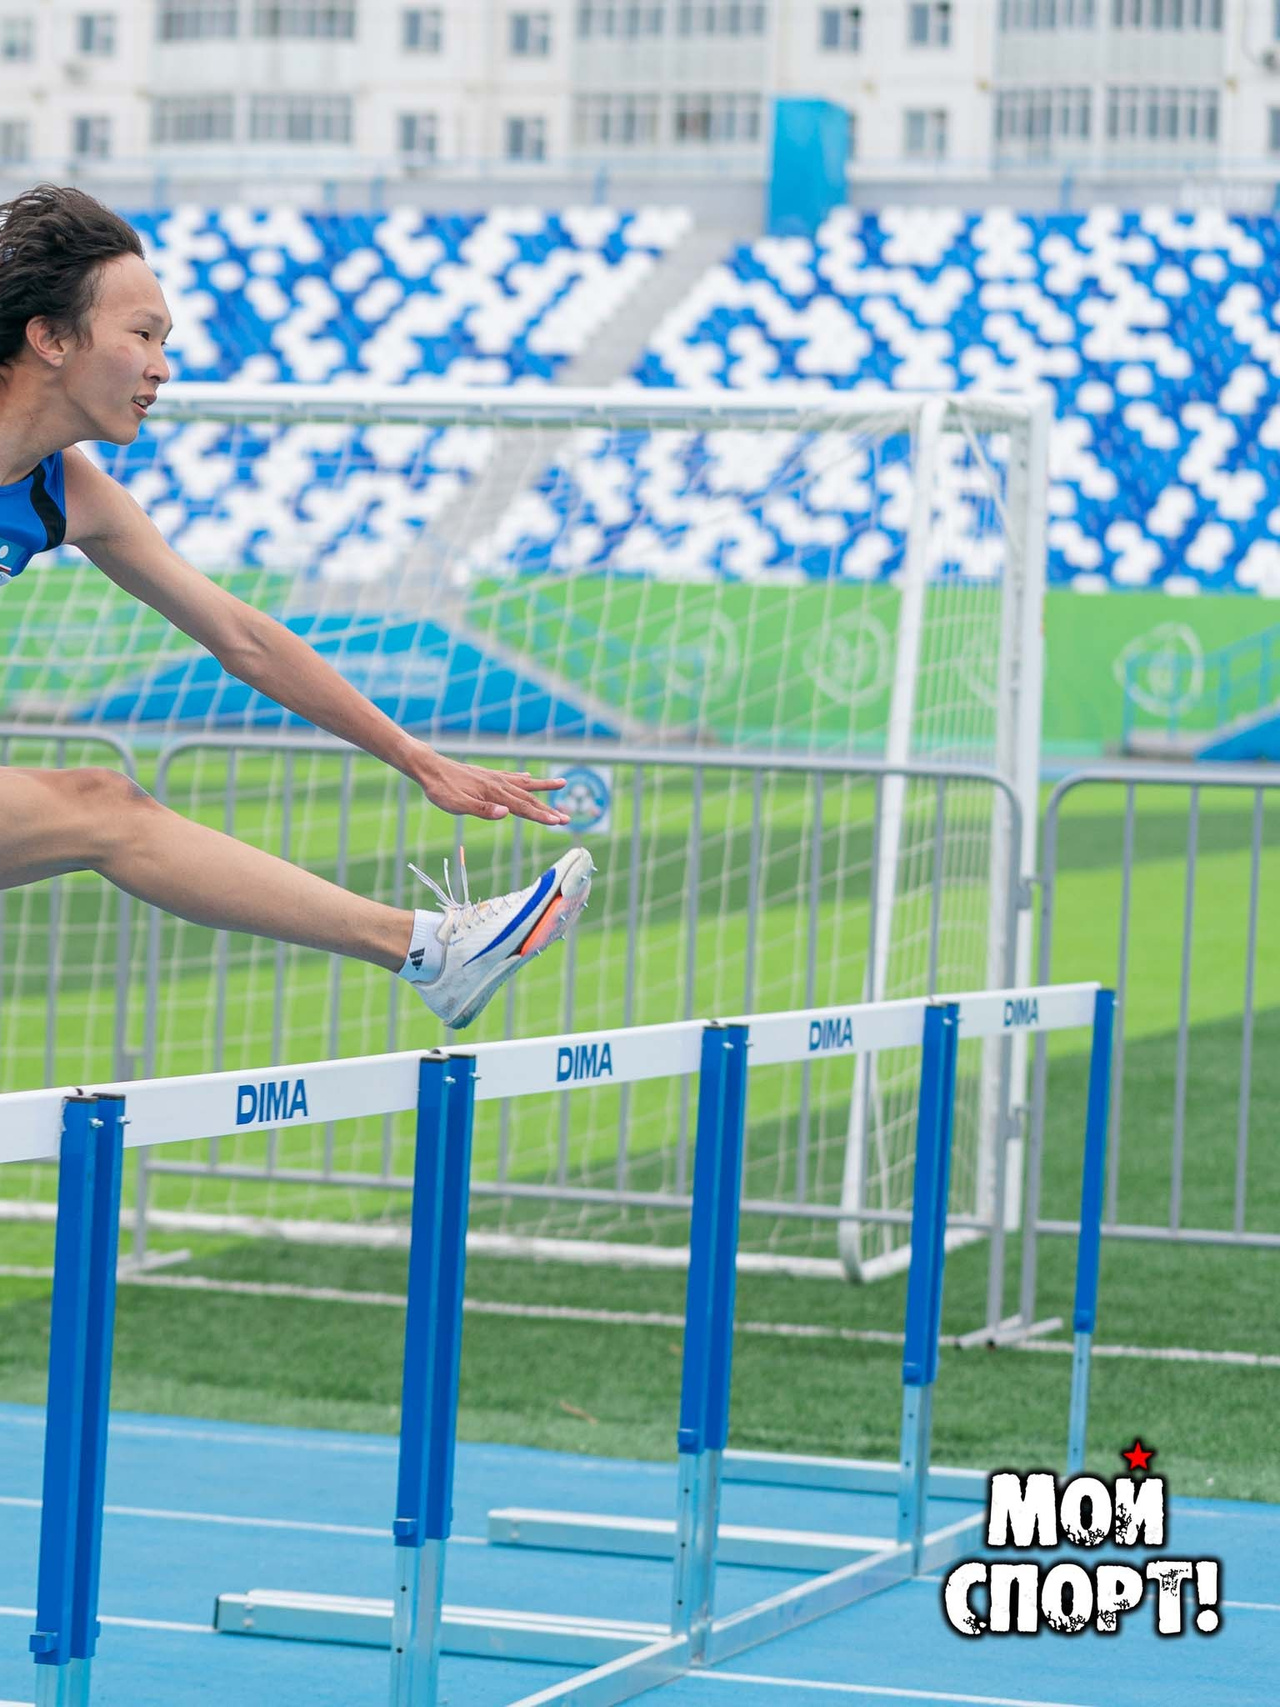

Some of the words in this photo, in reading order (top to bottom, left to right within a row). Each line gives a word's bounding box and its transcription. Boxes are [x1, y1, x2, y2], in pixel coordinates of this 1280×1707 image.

[1003, 998, 1039, 1028] DIMA
[808, 1017, 854, 1051] DIMA
[555, 1042, 614, 1083] DIMA
[235, 1079, 308, 1126] DIMA
